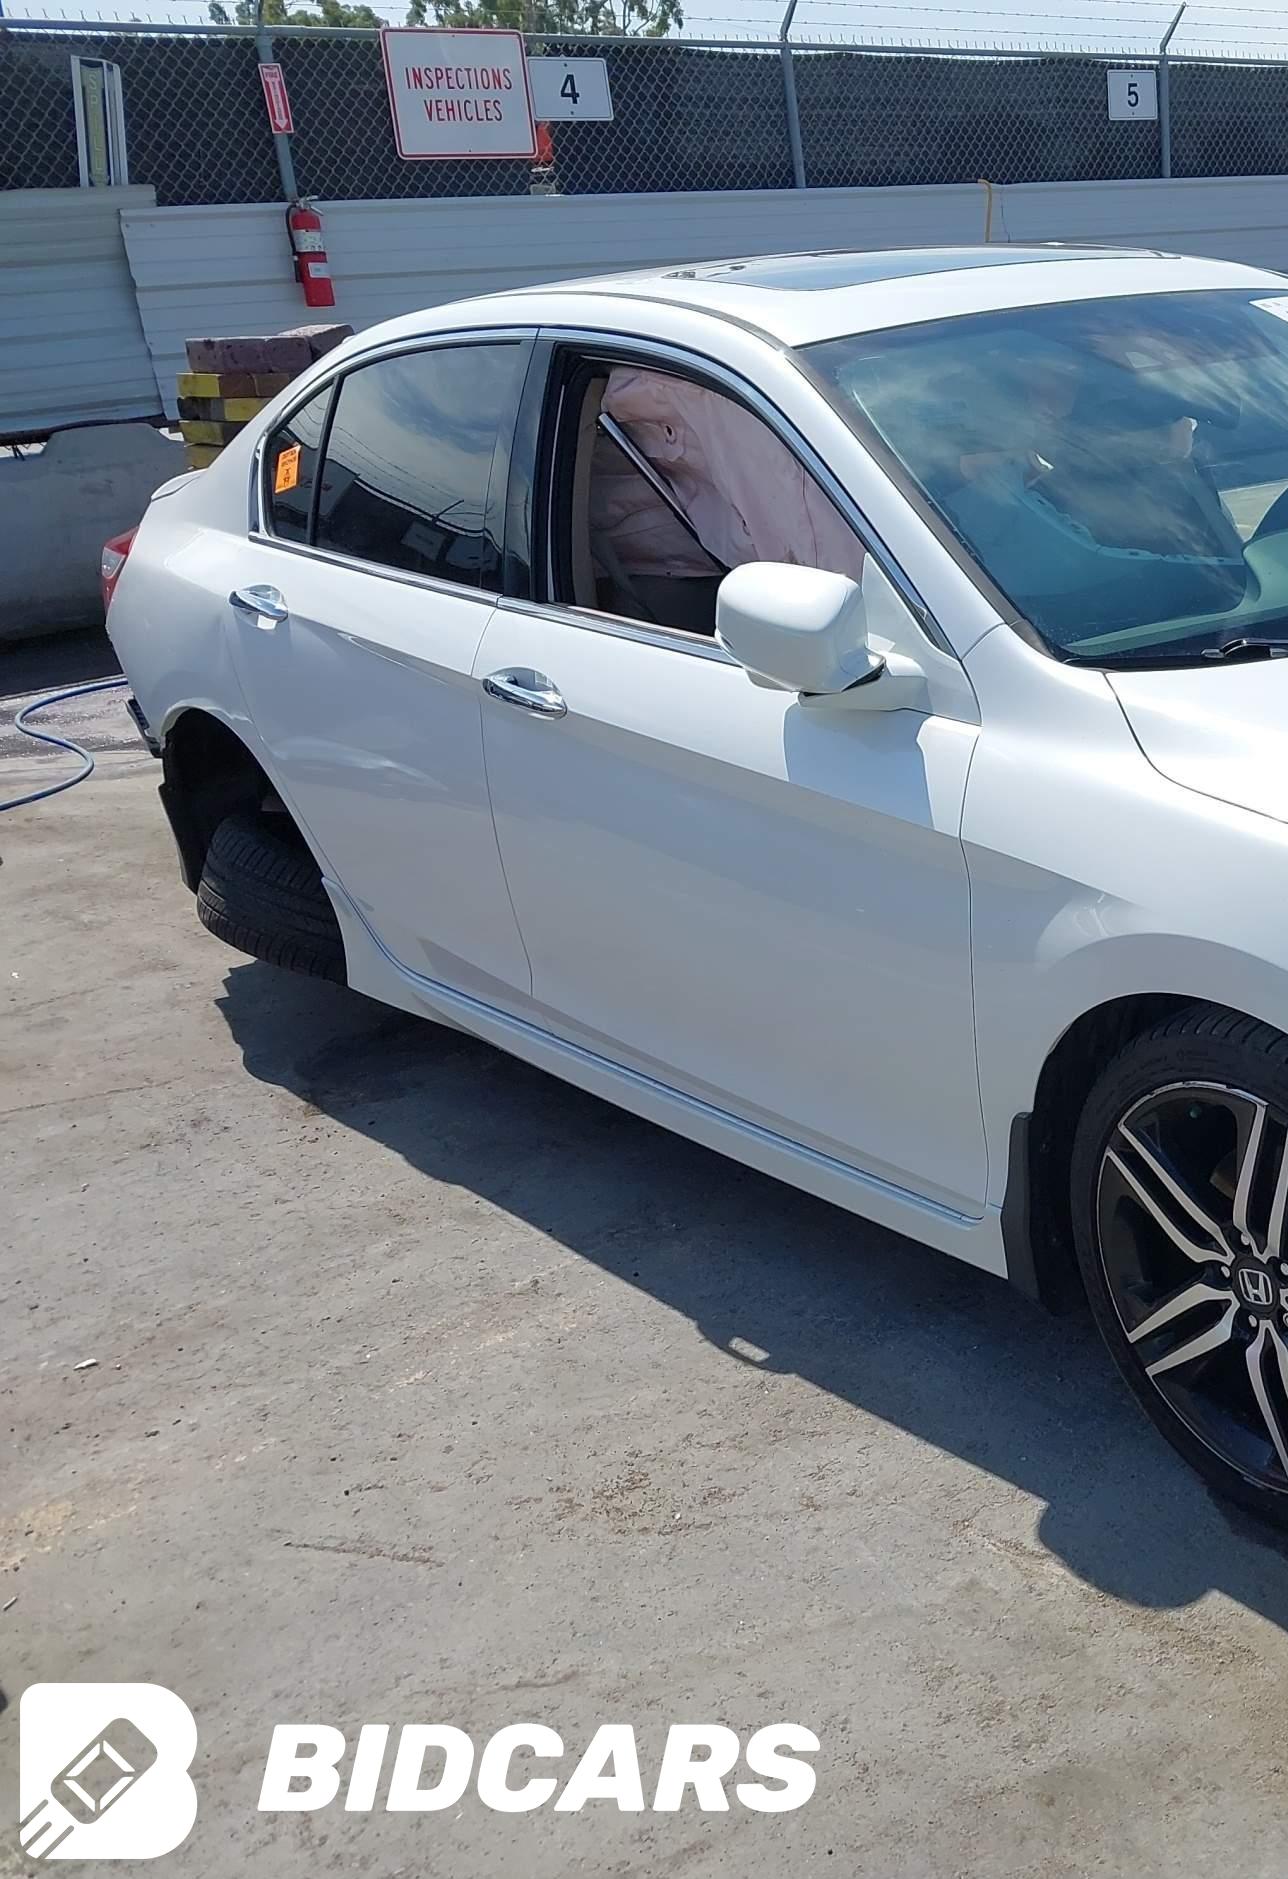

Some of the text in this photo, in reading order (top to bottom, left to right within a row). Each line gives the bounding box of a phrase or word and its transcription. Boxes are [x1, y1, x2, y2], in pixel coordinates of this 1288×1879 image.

[405, 67, 512, 90] INSPECTIONS
[560, 74, 580, 105] 4
[1127, 82, 1139, 107] 5
[424, 99, 503, 122] VEHICLES
